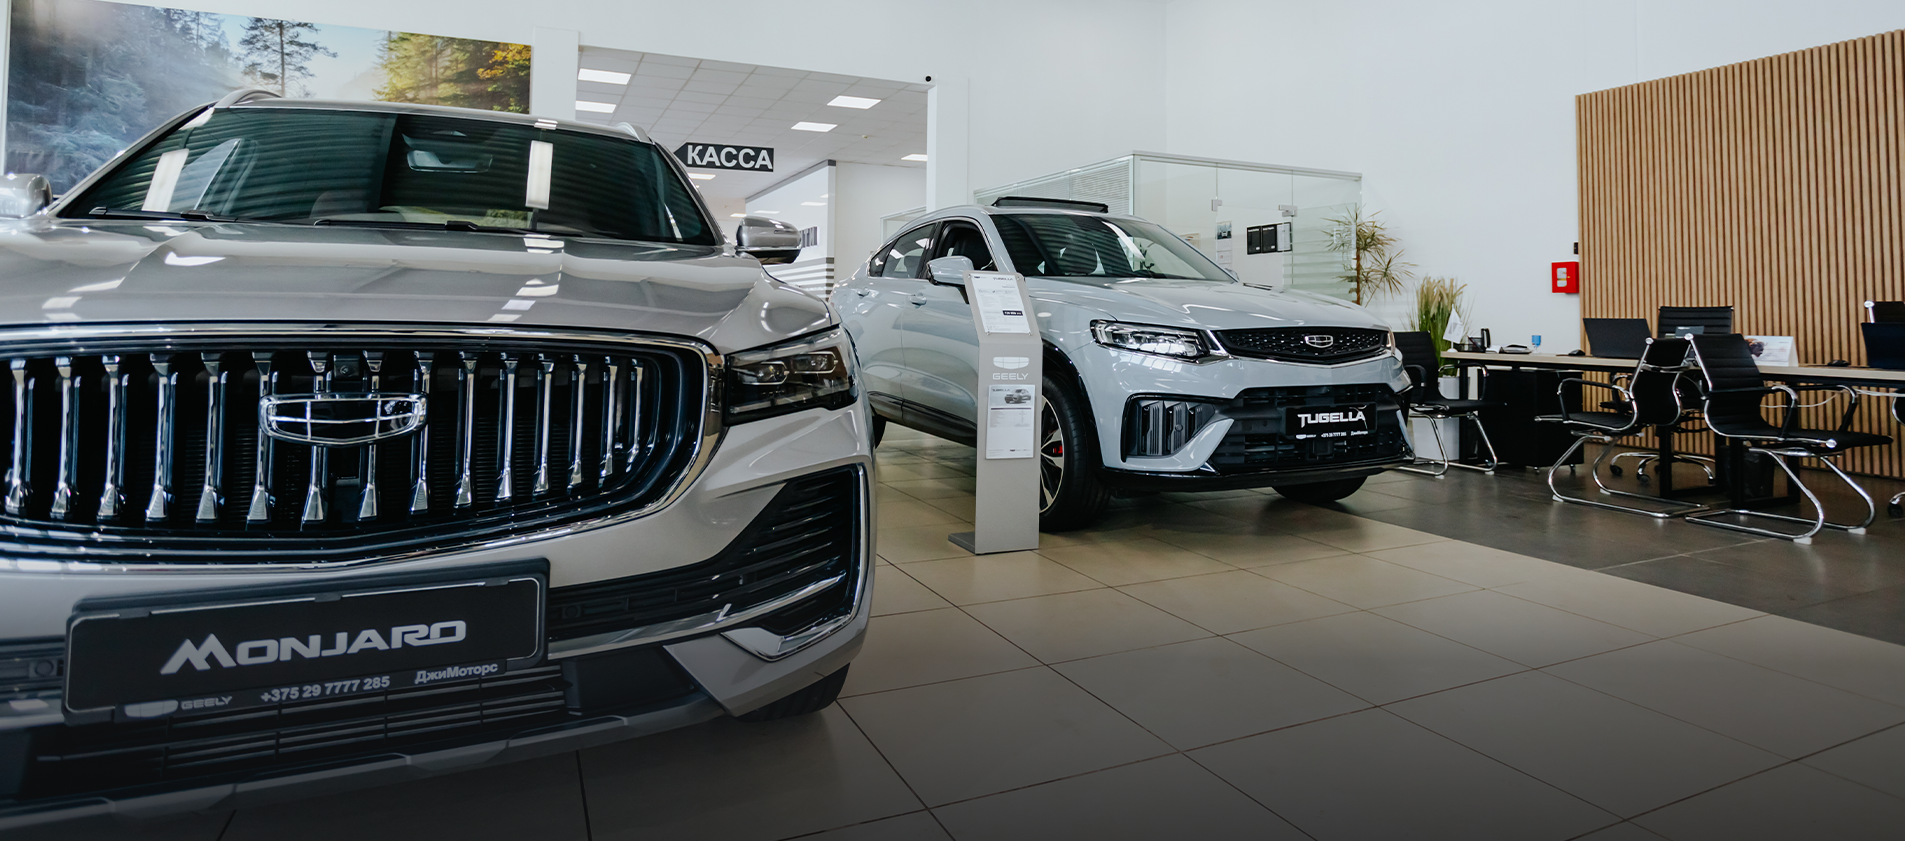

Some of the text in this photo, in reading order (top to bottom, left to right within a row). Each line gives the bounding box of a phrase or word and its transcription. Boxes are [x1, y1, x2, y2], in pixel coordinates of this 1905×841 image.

[687, 144, 773, 169] КАССА
[992, 372, 1029, 380] GEELY
[1297, 411, 1366, 428] TUGELLA
[160, 620, 466, 676] MONJARO
[414, 661, 499, 685] ДжиМоторс
[260, 675, 391, 703] +375 29 7777 285
[181, 695, 232, 710] GEELY
